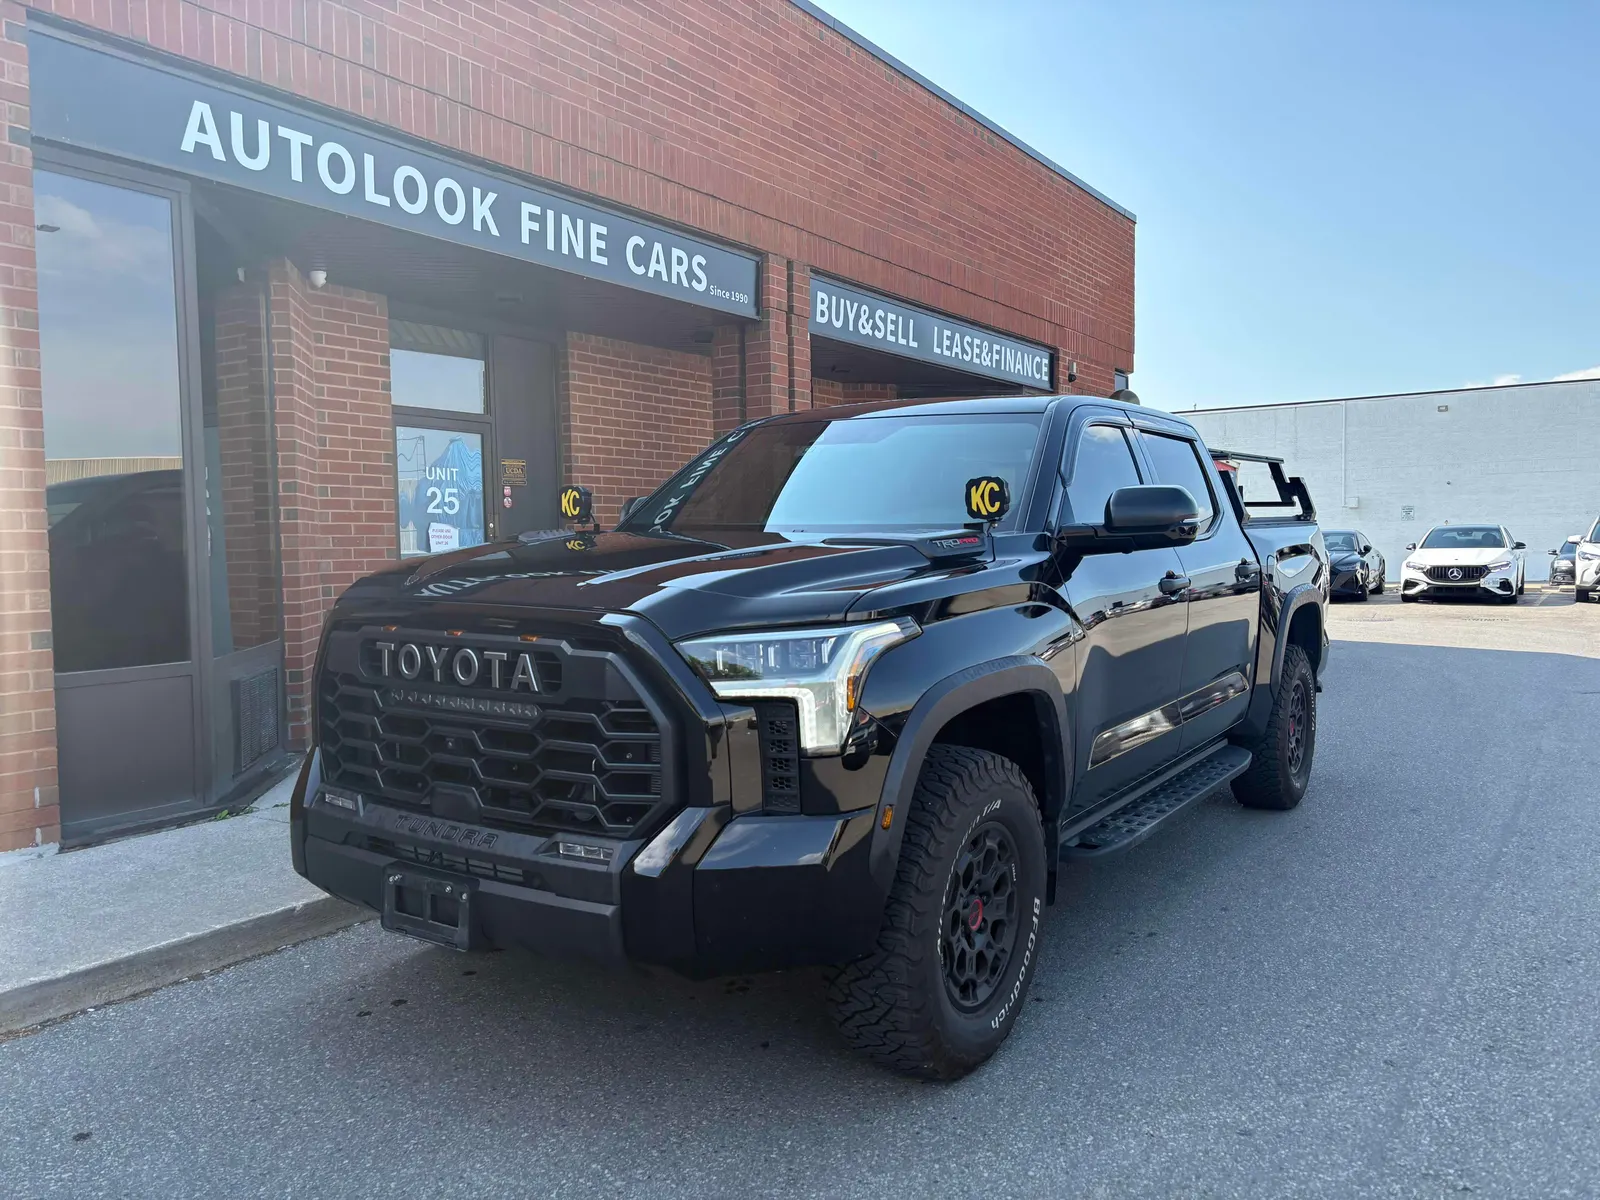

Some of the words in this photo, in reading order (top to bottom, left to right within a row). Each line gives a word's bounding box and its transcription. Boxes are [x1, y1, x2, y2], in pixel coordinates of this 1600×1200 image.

[181, 99, 501, 238] AUTOLOOK
[520, 200, 610, 267] FINE
[625, 235, 709, 293] CARS
[709, 284, 730, 299] Since
[730, 291, 749, 304] 1990
[815, 290, 918, 349] BUY&SELL
[932, 326, 1049, 382] LEASE&FINANCE
[425, 466, 459, 482] UNIT
[426, 486, 460, 515] 25
[561, 488, 580, 517] KC
[970, 480, 1001, 516] KC
[375, 641, 541, 693] TOYOTA
[982, 798, 1002, 818] T/A
[396, 814, 498, 850] TUNDRA
[991, 896, 1041, 1031] BFGoodrich
